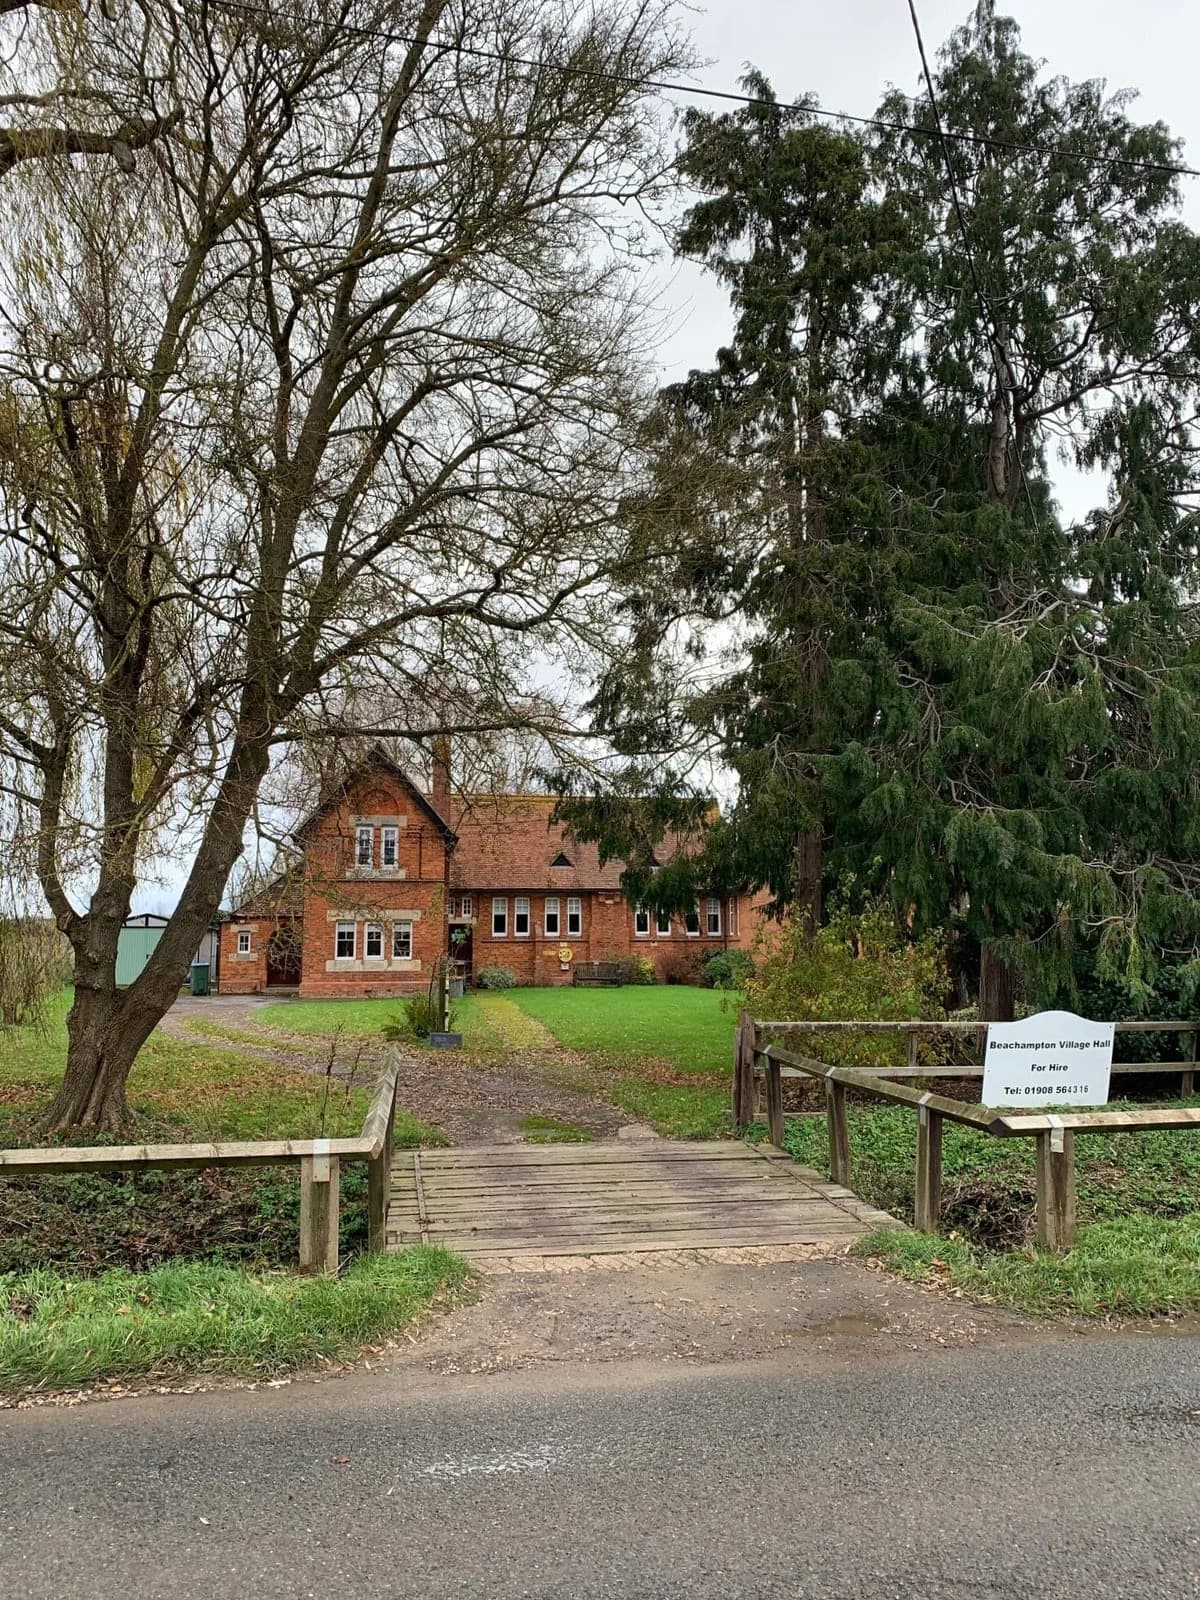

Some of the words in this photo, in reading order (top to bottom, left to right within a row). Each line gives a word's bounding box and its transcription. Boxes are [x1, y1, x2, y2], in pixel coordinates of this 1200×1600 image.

[990, 1041, 1056, 1050] Beachampton
[1059, 1040, 1090, 1050] Village
[1093, 1040, 1111, 1048] Hall
[1031, 1064, 1047, 1072] For
[1004, 1087, 1022, 1095] Tel:
[1024, 1086, 1053, 1095] 01908
